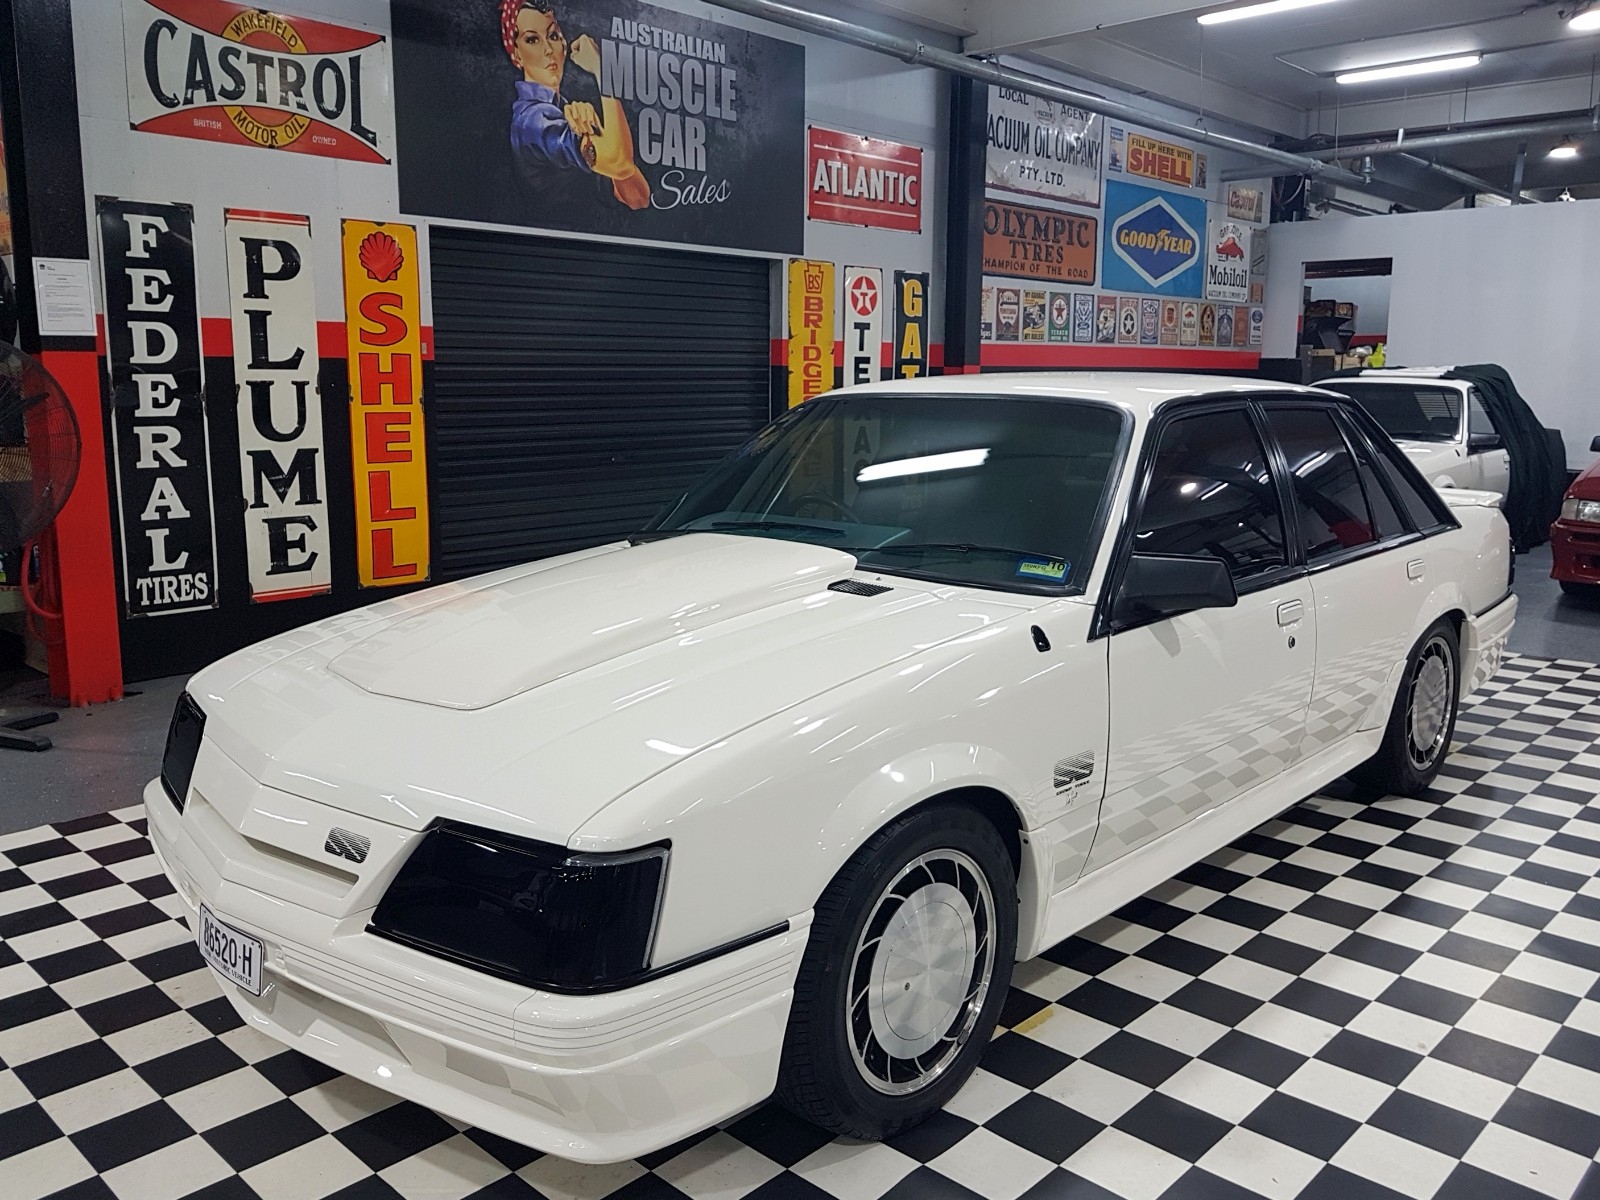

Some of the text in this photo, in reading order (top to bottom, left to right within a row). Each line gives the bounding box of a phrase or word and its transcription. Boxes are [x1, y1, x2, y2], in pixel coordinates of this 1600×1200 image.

[231, 12, 299, 50] WAKEFIELD
[611, 16, 727, 65] AUSTRALIAN
[143, 18, 378, 148] CASTROL
[601, 38, 738, 122] MUSCLE
[998, 86, 1090, 122] LOCAL AGENT
[193, 118, 222, 130] BRITISH
[232, 110, 306, 146] MOTOR OIL
[312, 135, 337, 147] OWNED
[638, 107, 707, 172] CAR
[985, 113, 1030, 155] ACUUM
[1034, 125, 1051, 160] OIL
[1129, 148, 1191, 184] SHELL
[1131, 138, 1192, 161] FILL UP HERE WITH
[650, 170, 732, 210] Sales
[813, 158, 917, 207] ATLANTIC
[983, 205, 1090, 249] OLYMPIC
[983, 258, 1089, 279] HAMPION OF THE ROAD
[1009, 240, 1064, 264] TYRES
[807, 274, 821, 291] BS
[1208, 264, 1248, 289] Mobiloil
[803, 296, 824, 401] BRIDGE
[122, 213, 191, 572] FEDERAL
[239, 237, 323, 576] PLUME
[358, 292, 418, 580] SHELL
[136, 572, 209, 606] TIRES
